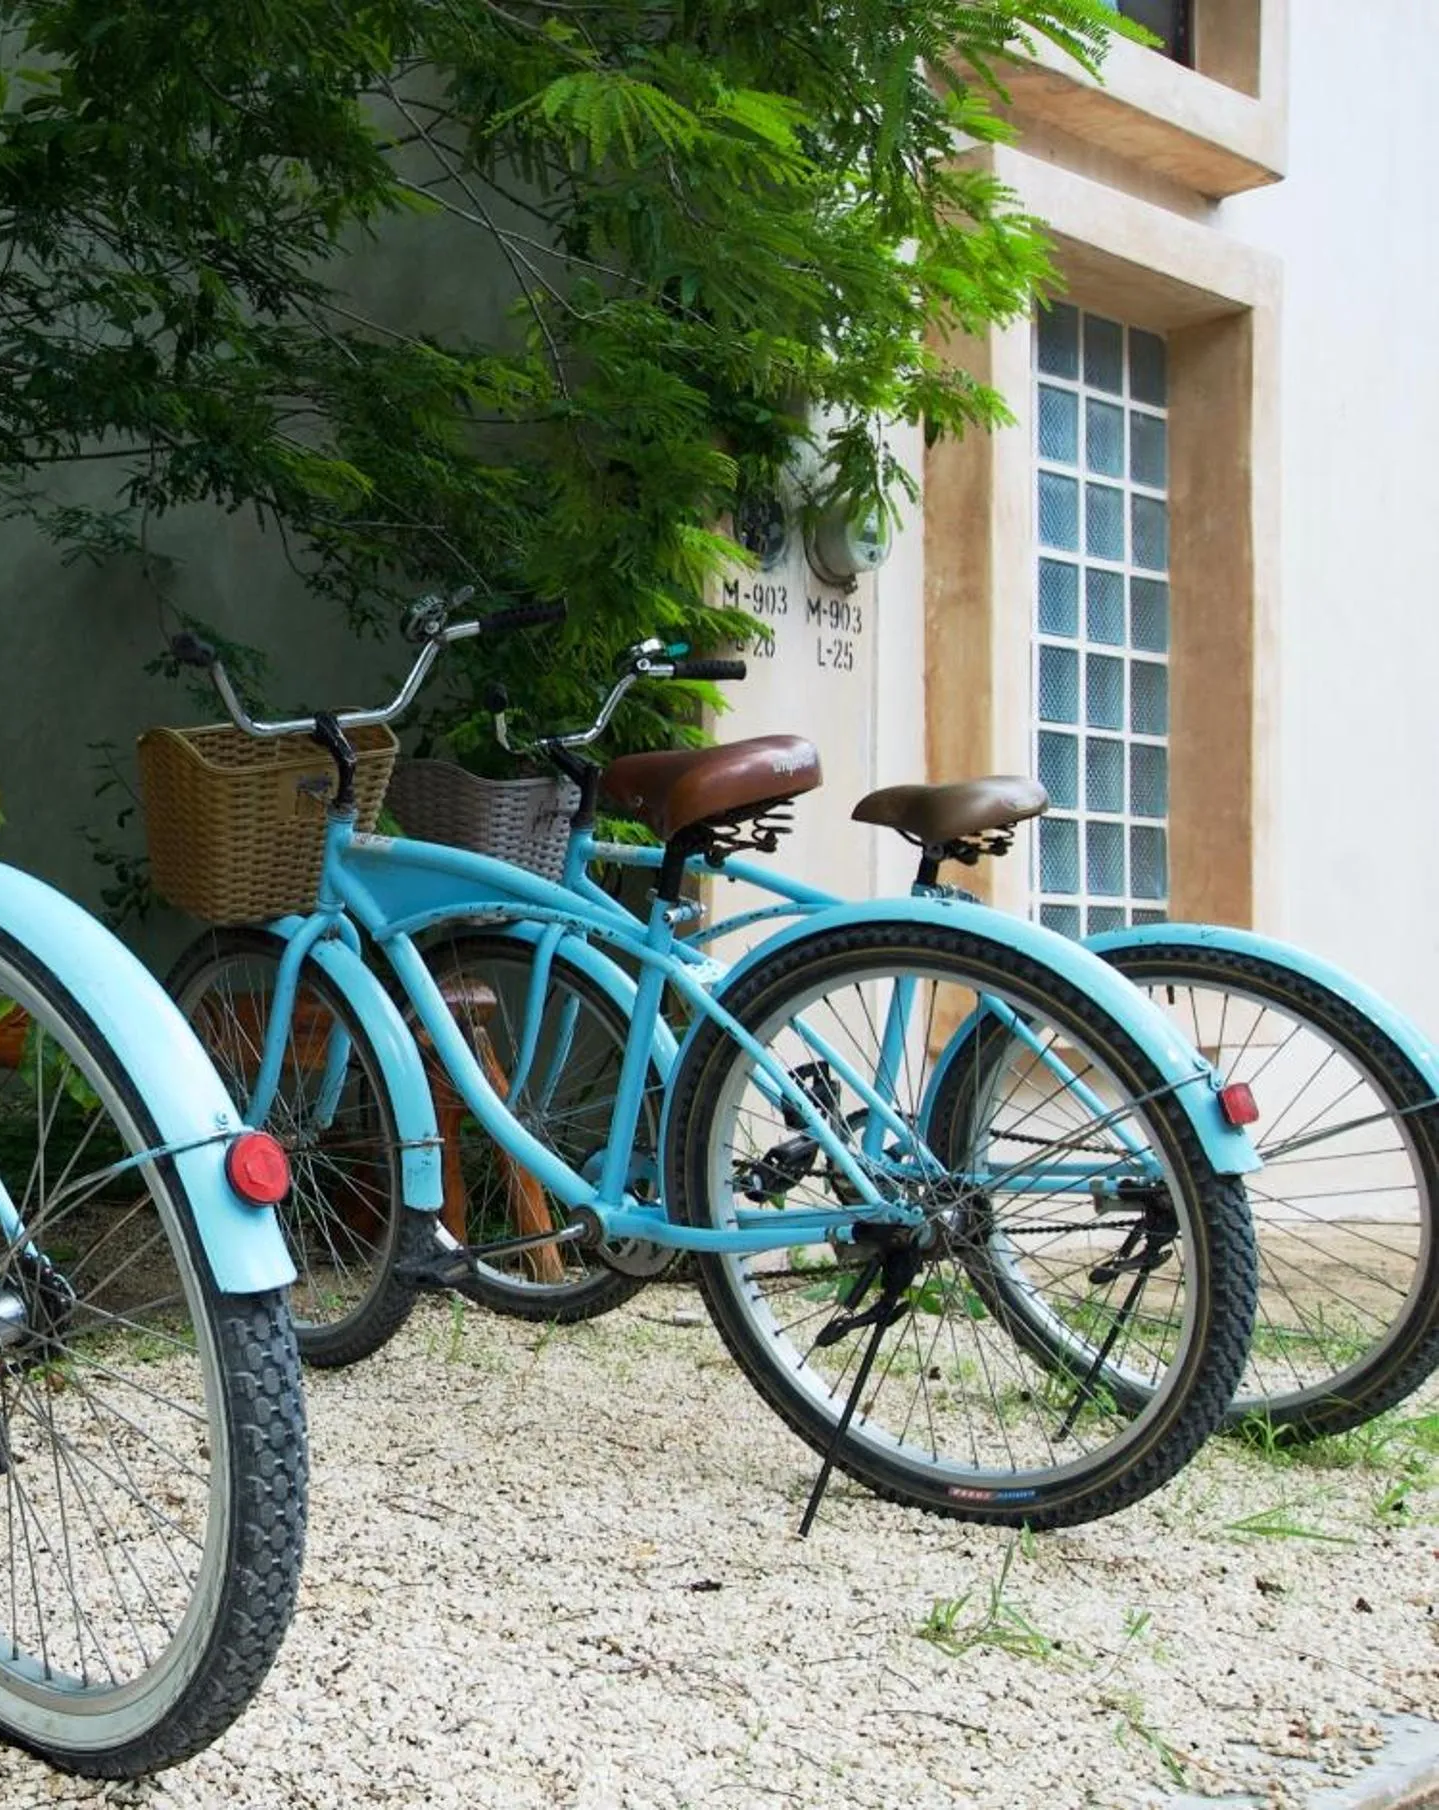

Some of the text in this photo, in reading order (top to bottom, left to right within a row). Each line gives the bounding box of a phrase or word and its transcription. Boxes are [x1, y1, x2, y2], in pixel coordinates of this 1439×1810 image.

[722, 579, 788, 615] M-903
[806, 596, 862, 634] M-903
[816, 637, 854, 671] L-25
